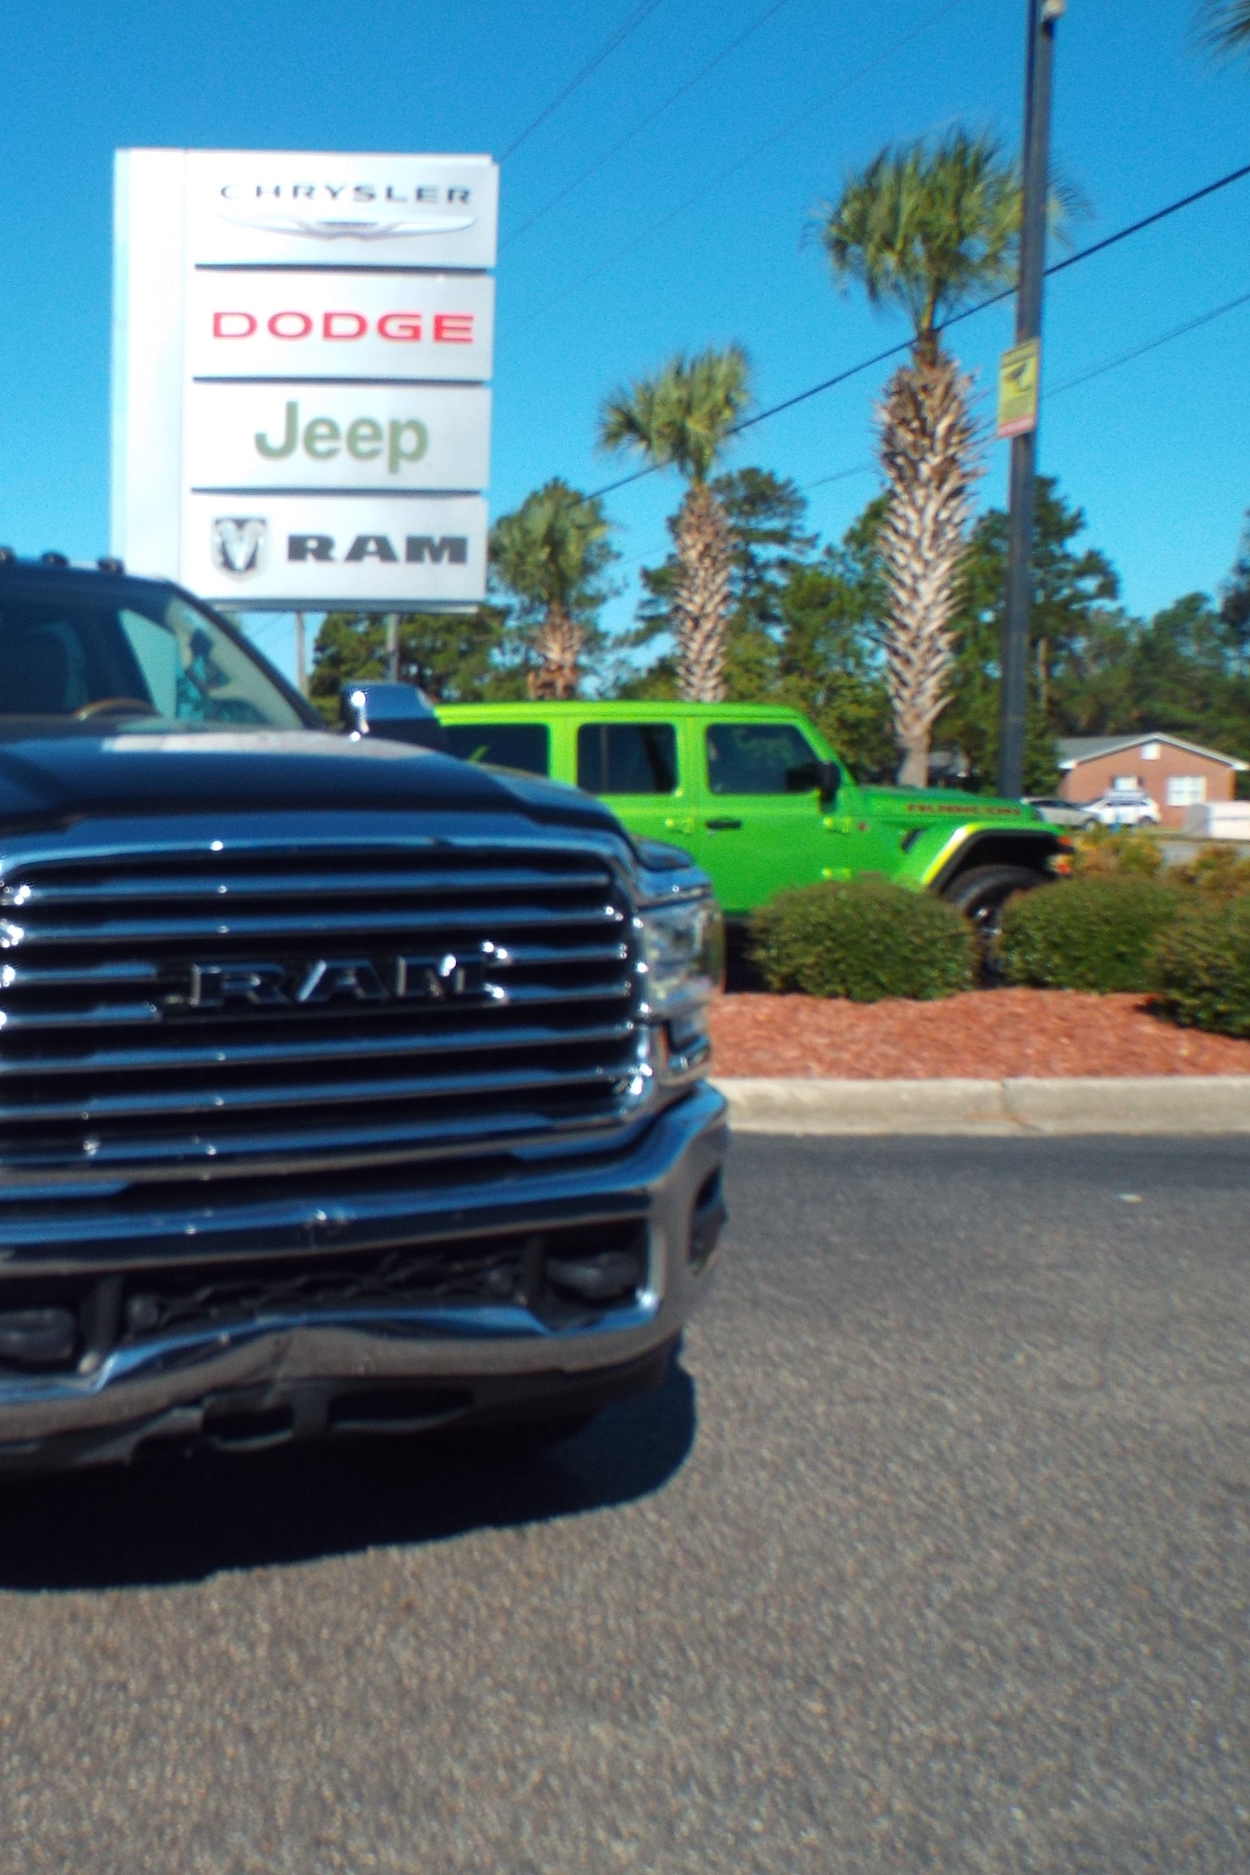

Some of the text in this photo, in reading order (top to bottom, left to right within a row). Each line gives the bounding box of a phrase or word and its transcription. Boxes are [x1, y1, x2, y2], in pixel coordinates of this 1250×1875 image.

[220, 184, 471, 204] CHRYSLER
[213, 311, 474, 343] DODGE
[255, 401, 428, 473] Jeep
[287, 535, 468, 564] RAM
[190, 956, 487, 1006] RAM
